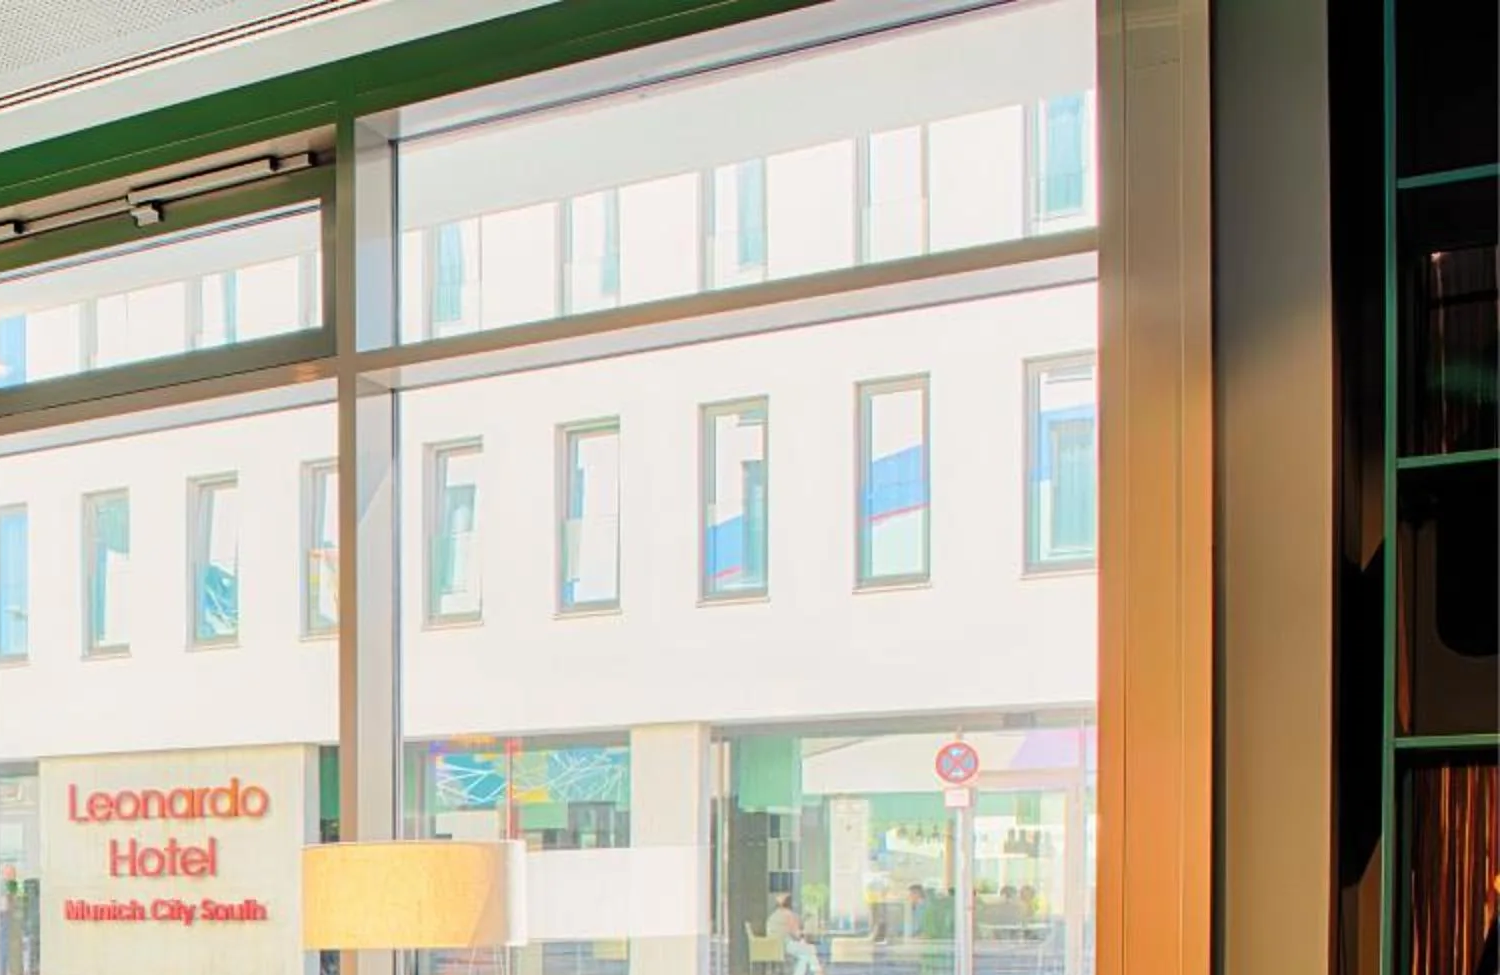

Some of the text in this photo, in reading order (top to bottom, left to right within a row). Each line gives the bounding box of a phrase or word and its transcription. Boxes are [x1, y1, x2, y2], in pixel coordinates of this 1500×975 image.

[67, 777, 269, 822] Leonardo
[109, 837, 217, 877] Hotel
[65, 898, 268, 926] Munich City South
